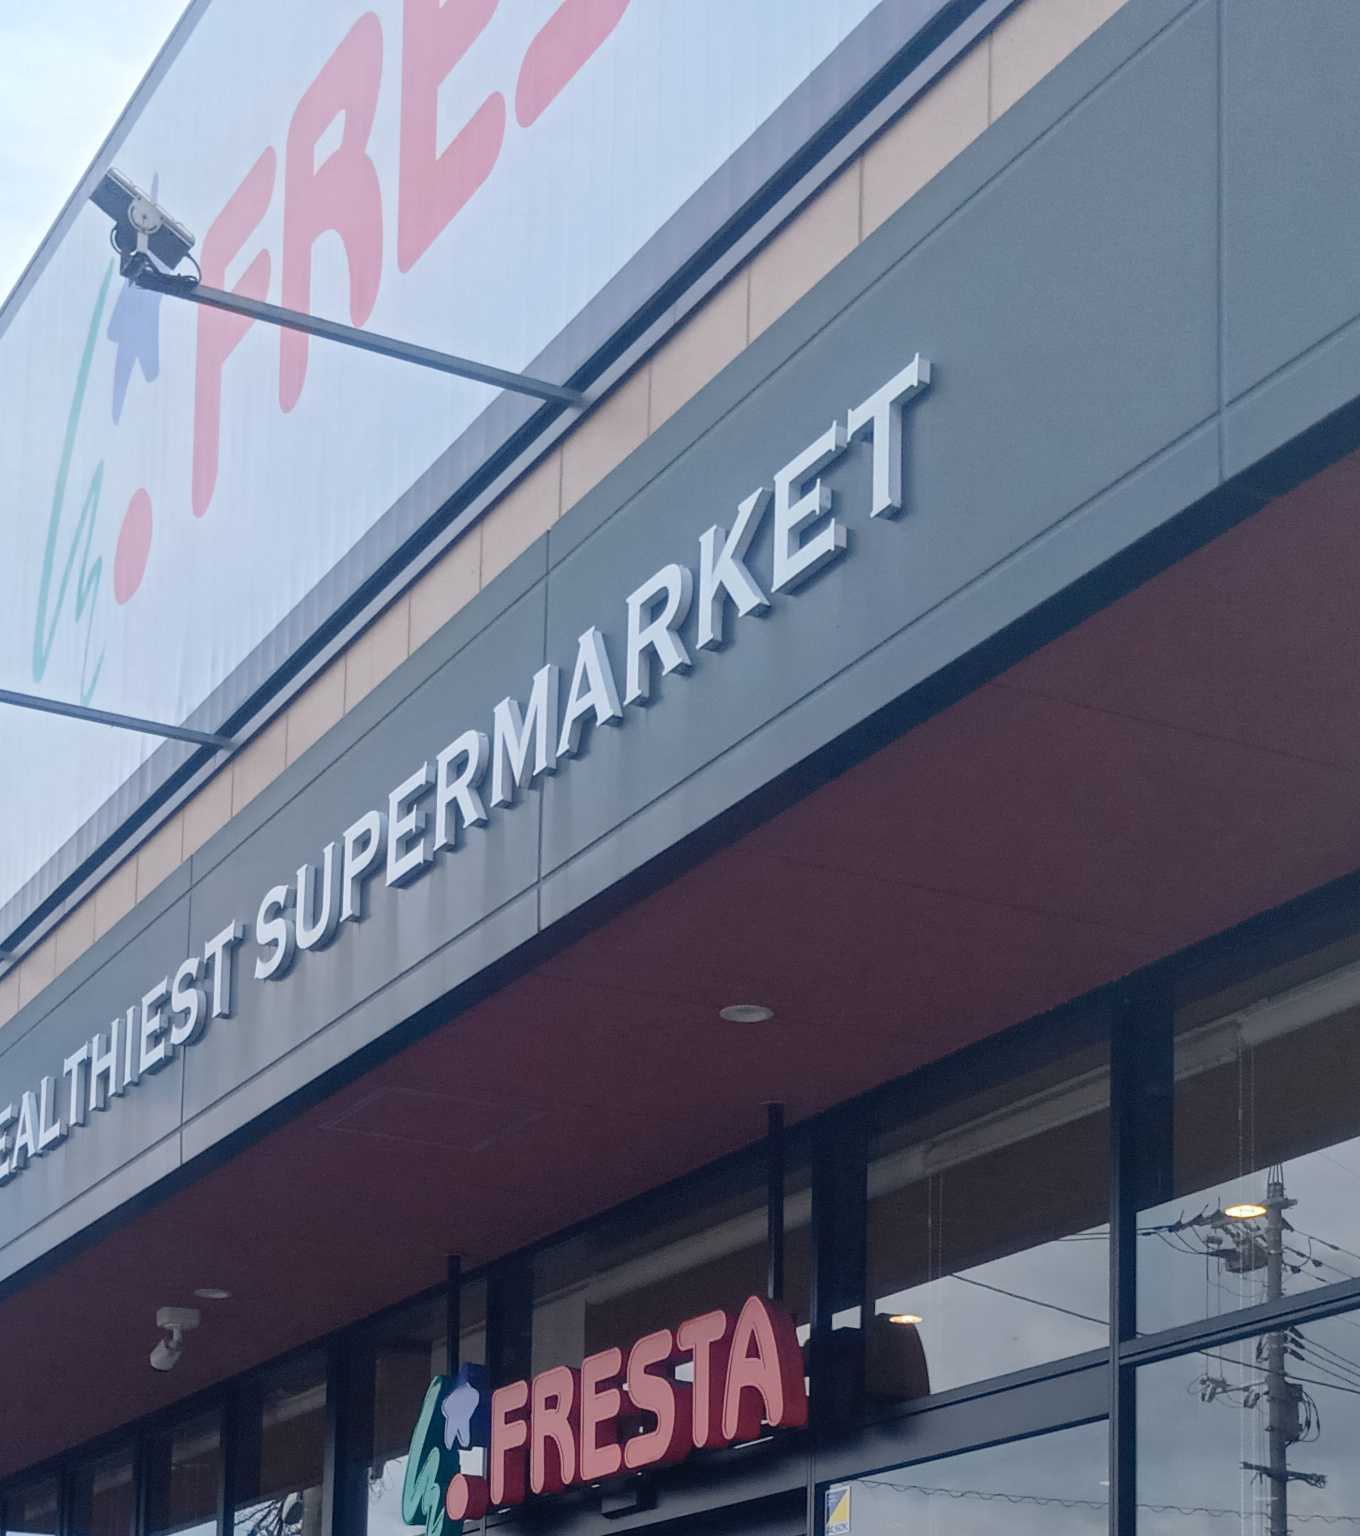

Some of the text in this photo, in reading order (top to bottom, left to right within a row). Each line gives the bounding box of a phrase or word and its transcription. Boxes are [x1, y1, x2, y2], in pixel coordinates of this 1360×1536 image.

[191, 0, 632, 519] FRE
[252, 352, 933, 981] SUPERMARKET
[489, 1295, 795, 1507] FRESTA
